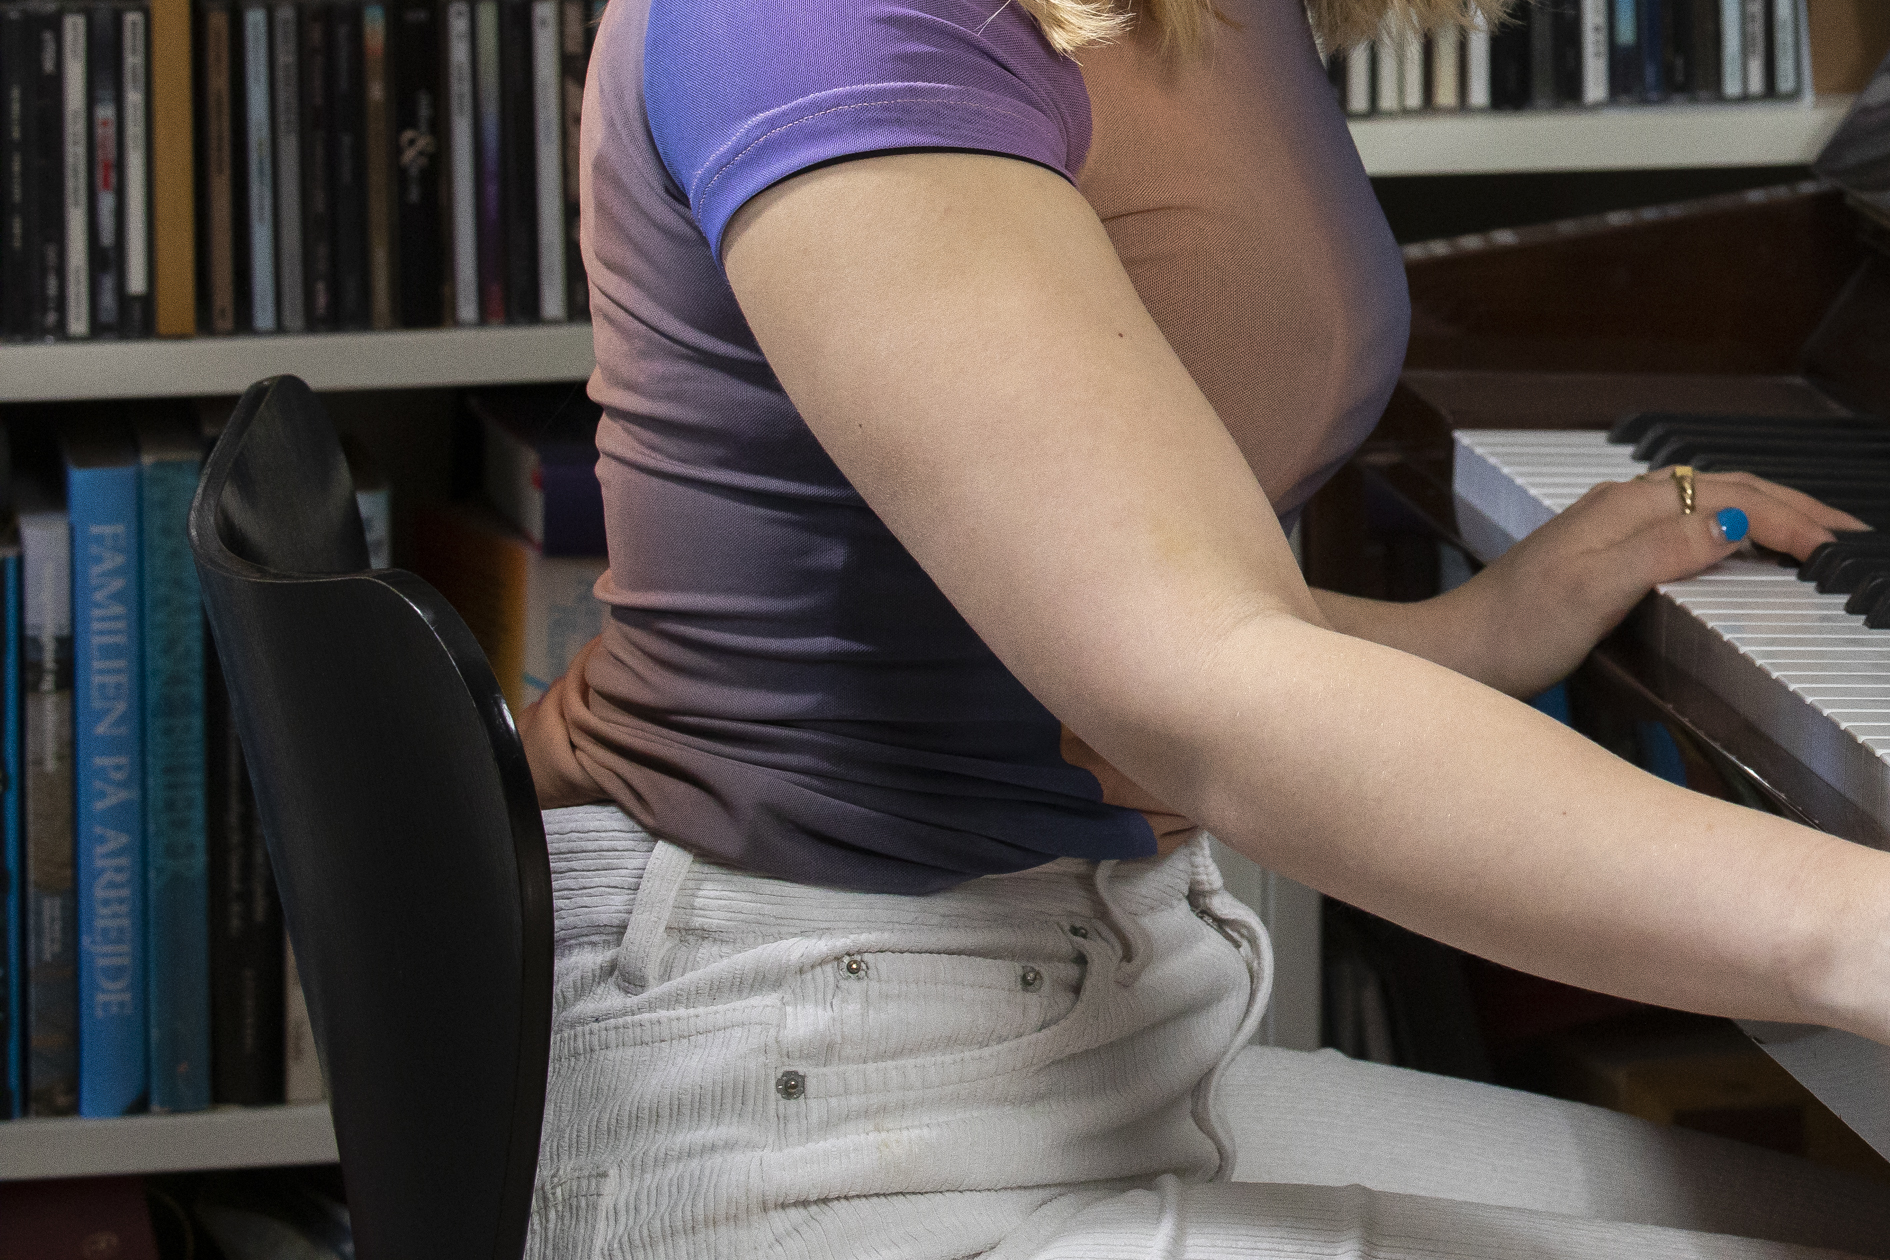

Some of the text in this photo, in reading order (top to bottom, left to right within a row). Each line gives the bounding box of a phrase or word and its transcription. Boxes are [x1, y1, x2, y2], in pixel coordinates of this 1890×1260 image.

[90, 521, 135, 1020] FAMILIEN PÅ ARBEJDE
